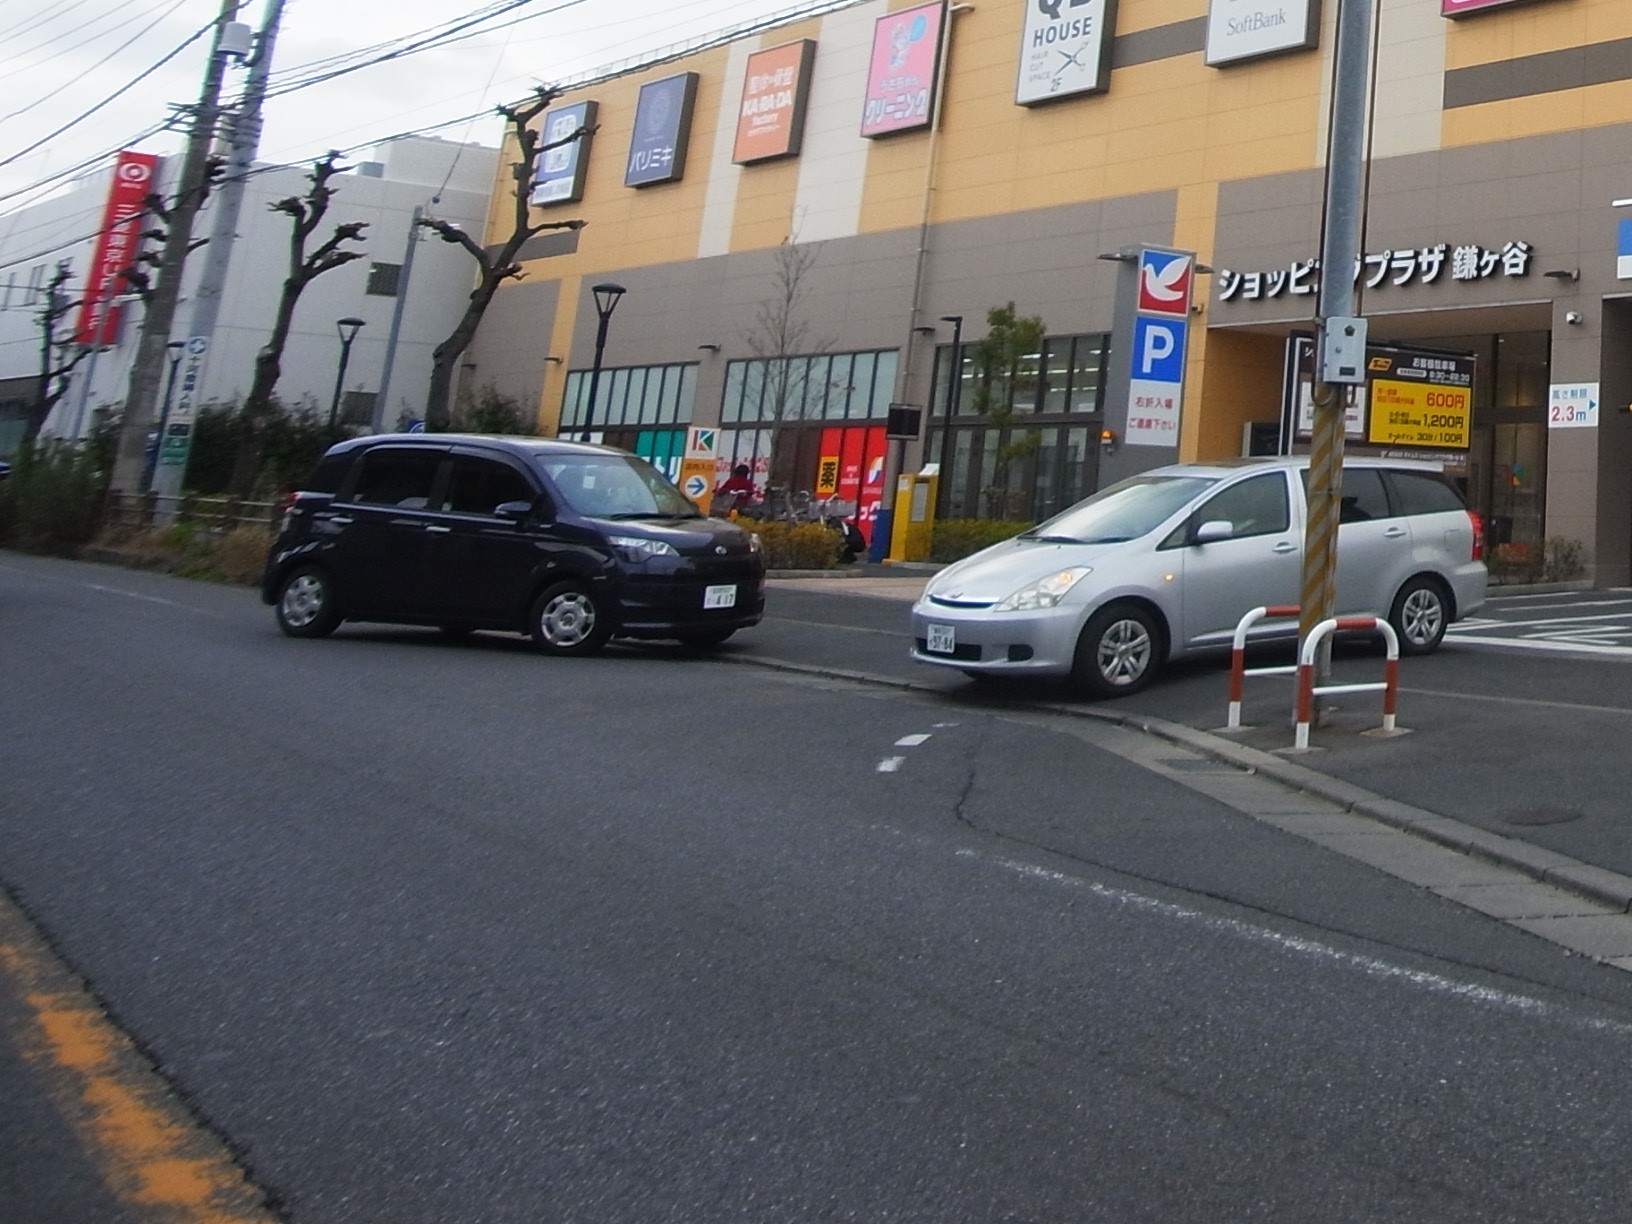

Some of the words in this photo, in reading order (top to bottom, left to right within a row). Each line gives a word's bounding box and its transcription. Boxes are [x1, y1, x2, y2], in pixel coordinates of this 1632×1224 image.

[1226, 7, 1287, 37] SoftBank
[1032, 16, 1093, 48] HOUSE
[1031, 50, 1049, 61] HAIR
[1029, 62, 1044, 72] CUT
[1028, 71, 1051, 83] SPACE
[1050, 77, 1063, 92] 2F
[629, 145, 673, 173] パリミキ
[1142, 324, 1174, 373] P
[1135, 397, 1174, 410] 右折入場
[1426, 392, 1465, 409] 600円
[1423, 413, 1464, 429] 1,200円
[1551, 405, 1587, 422] 2.3m
[1128, 418, 1176, 430] ご遠慮下さい
